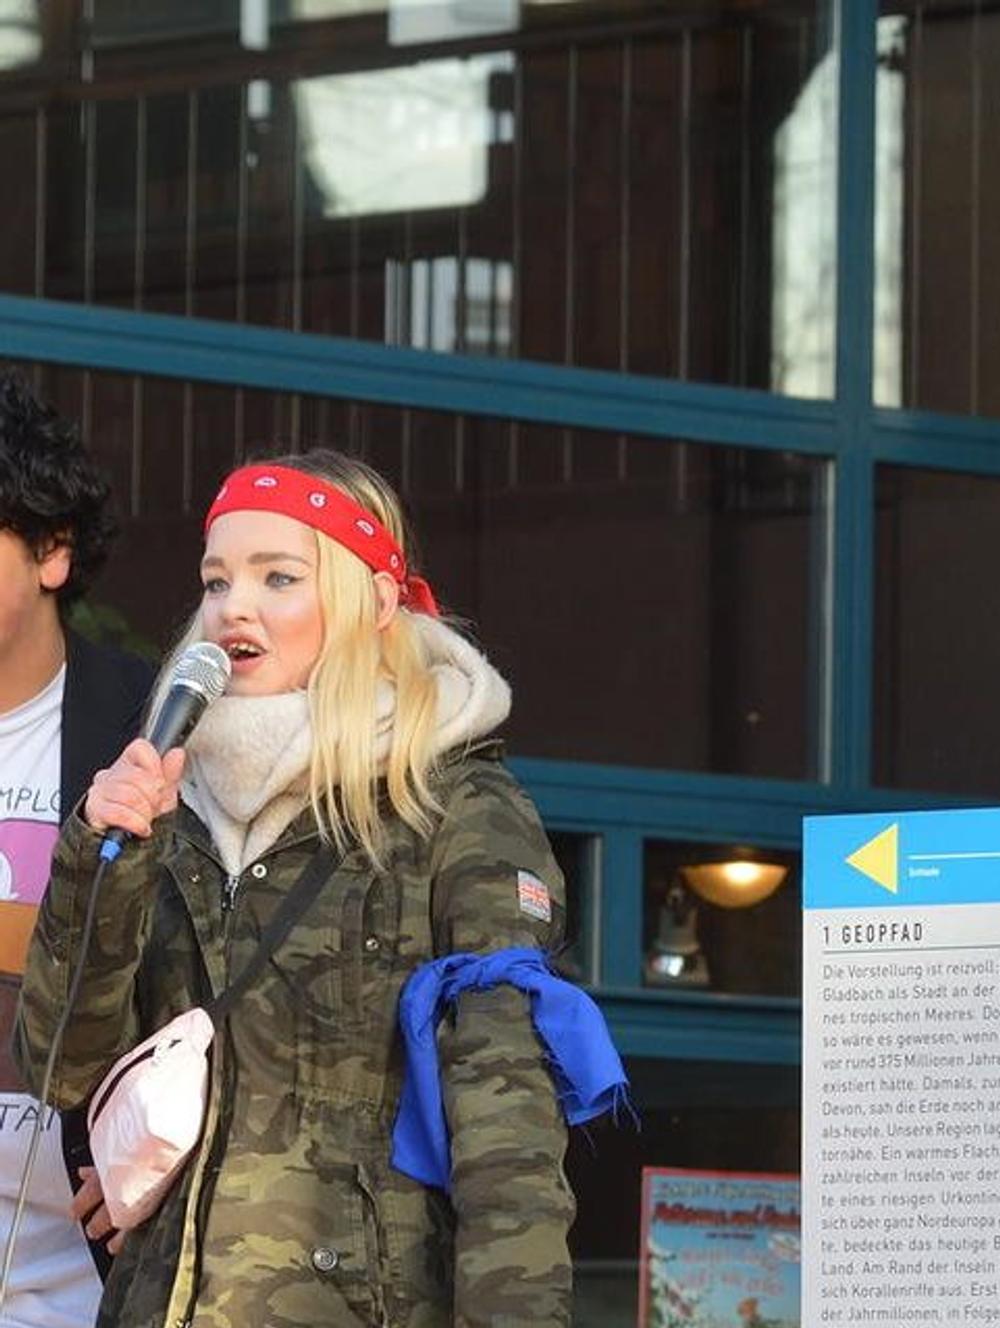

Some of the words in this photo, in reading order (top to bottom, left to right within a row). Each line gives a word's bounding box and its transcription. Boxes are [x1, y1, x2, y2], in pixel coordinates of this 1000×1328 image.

[822, 926, 830, 944] 1
[842, 923, 923, 944] GEOPFAD
[822, 966, 845, 979] Die
[848, 964, 923, 981] Vorstellung
[822, 987, 884, 1000] Gladbach
[912, 985, 948, 998] Stadt
[972, 983, 996, 997] der
[822, 1015, 846, 1025] nes
[849, 1009, 920, 1026] tropischen
[962, 1033, 998, 1043] wenn
[845, 1056, 876, 1069] rund
[878, 1055, 901, 1068] 375
[904, 1054, 965, 1067] Millionen
[919, 1100, 950, 1113] Erde
[952, 1099, 985, 1112] noch
[0, 1104, 57, 1131] TA
[887, 1123, 933, 1136] Unsere
[936, 1122, 981, 1139] Region
[881, 1147, 902, 1160] Ein
[905, 1149, 959, 1159] warmes
[822, 1170, 898, 1184] zahlreichen
[903, 1169, 945, 1182] Inseln
[976, 1168, 999, 1181] der
[839, 1193, 875, 1207] eines
[881, 1192, 936, 1209] riesigen
[821, 1216, 847, 1230] sich
[883, 1219, 915, 1232] ganz
[917, 1215, 996, 1232] Nordeuropa
[843, 1238, 902, 1252] bedeckte
[908, 1238, 932, 1251] das
[937, 1237, 988, 1254] heutige
[862, 1261, 884, 1275] Am
[888, 1261, 922, 1274] Rand
[953, 1260, 996, 1273] Inseln
[851, 1284, 935, 1298] Korallenriffe
[970, 1283, 999, 1297] Erst
[964, 1306, 1000, 1323] Folge
